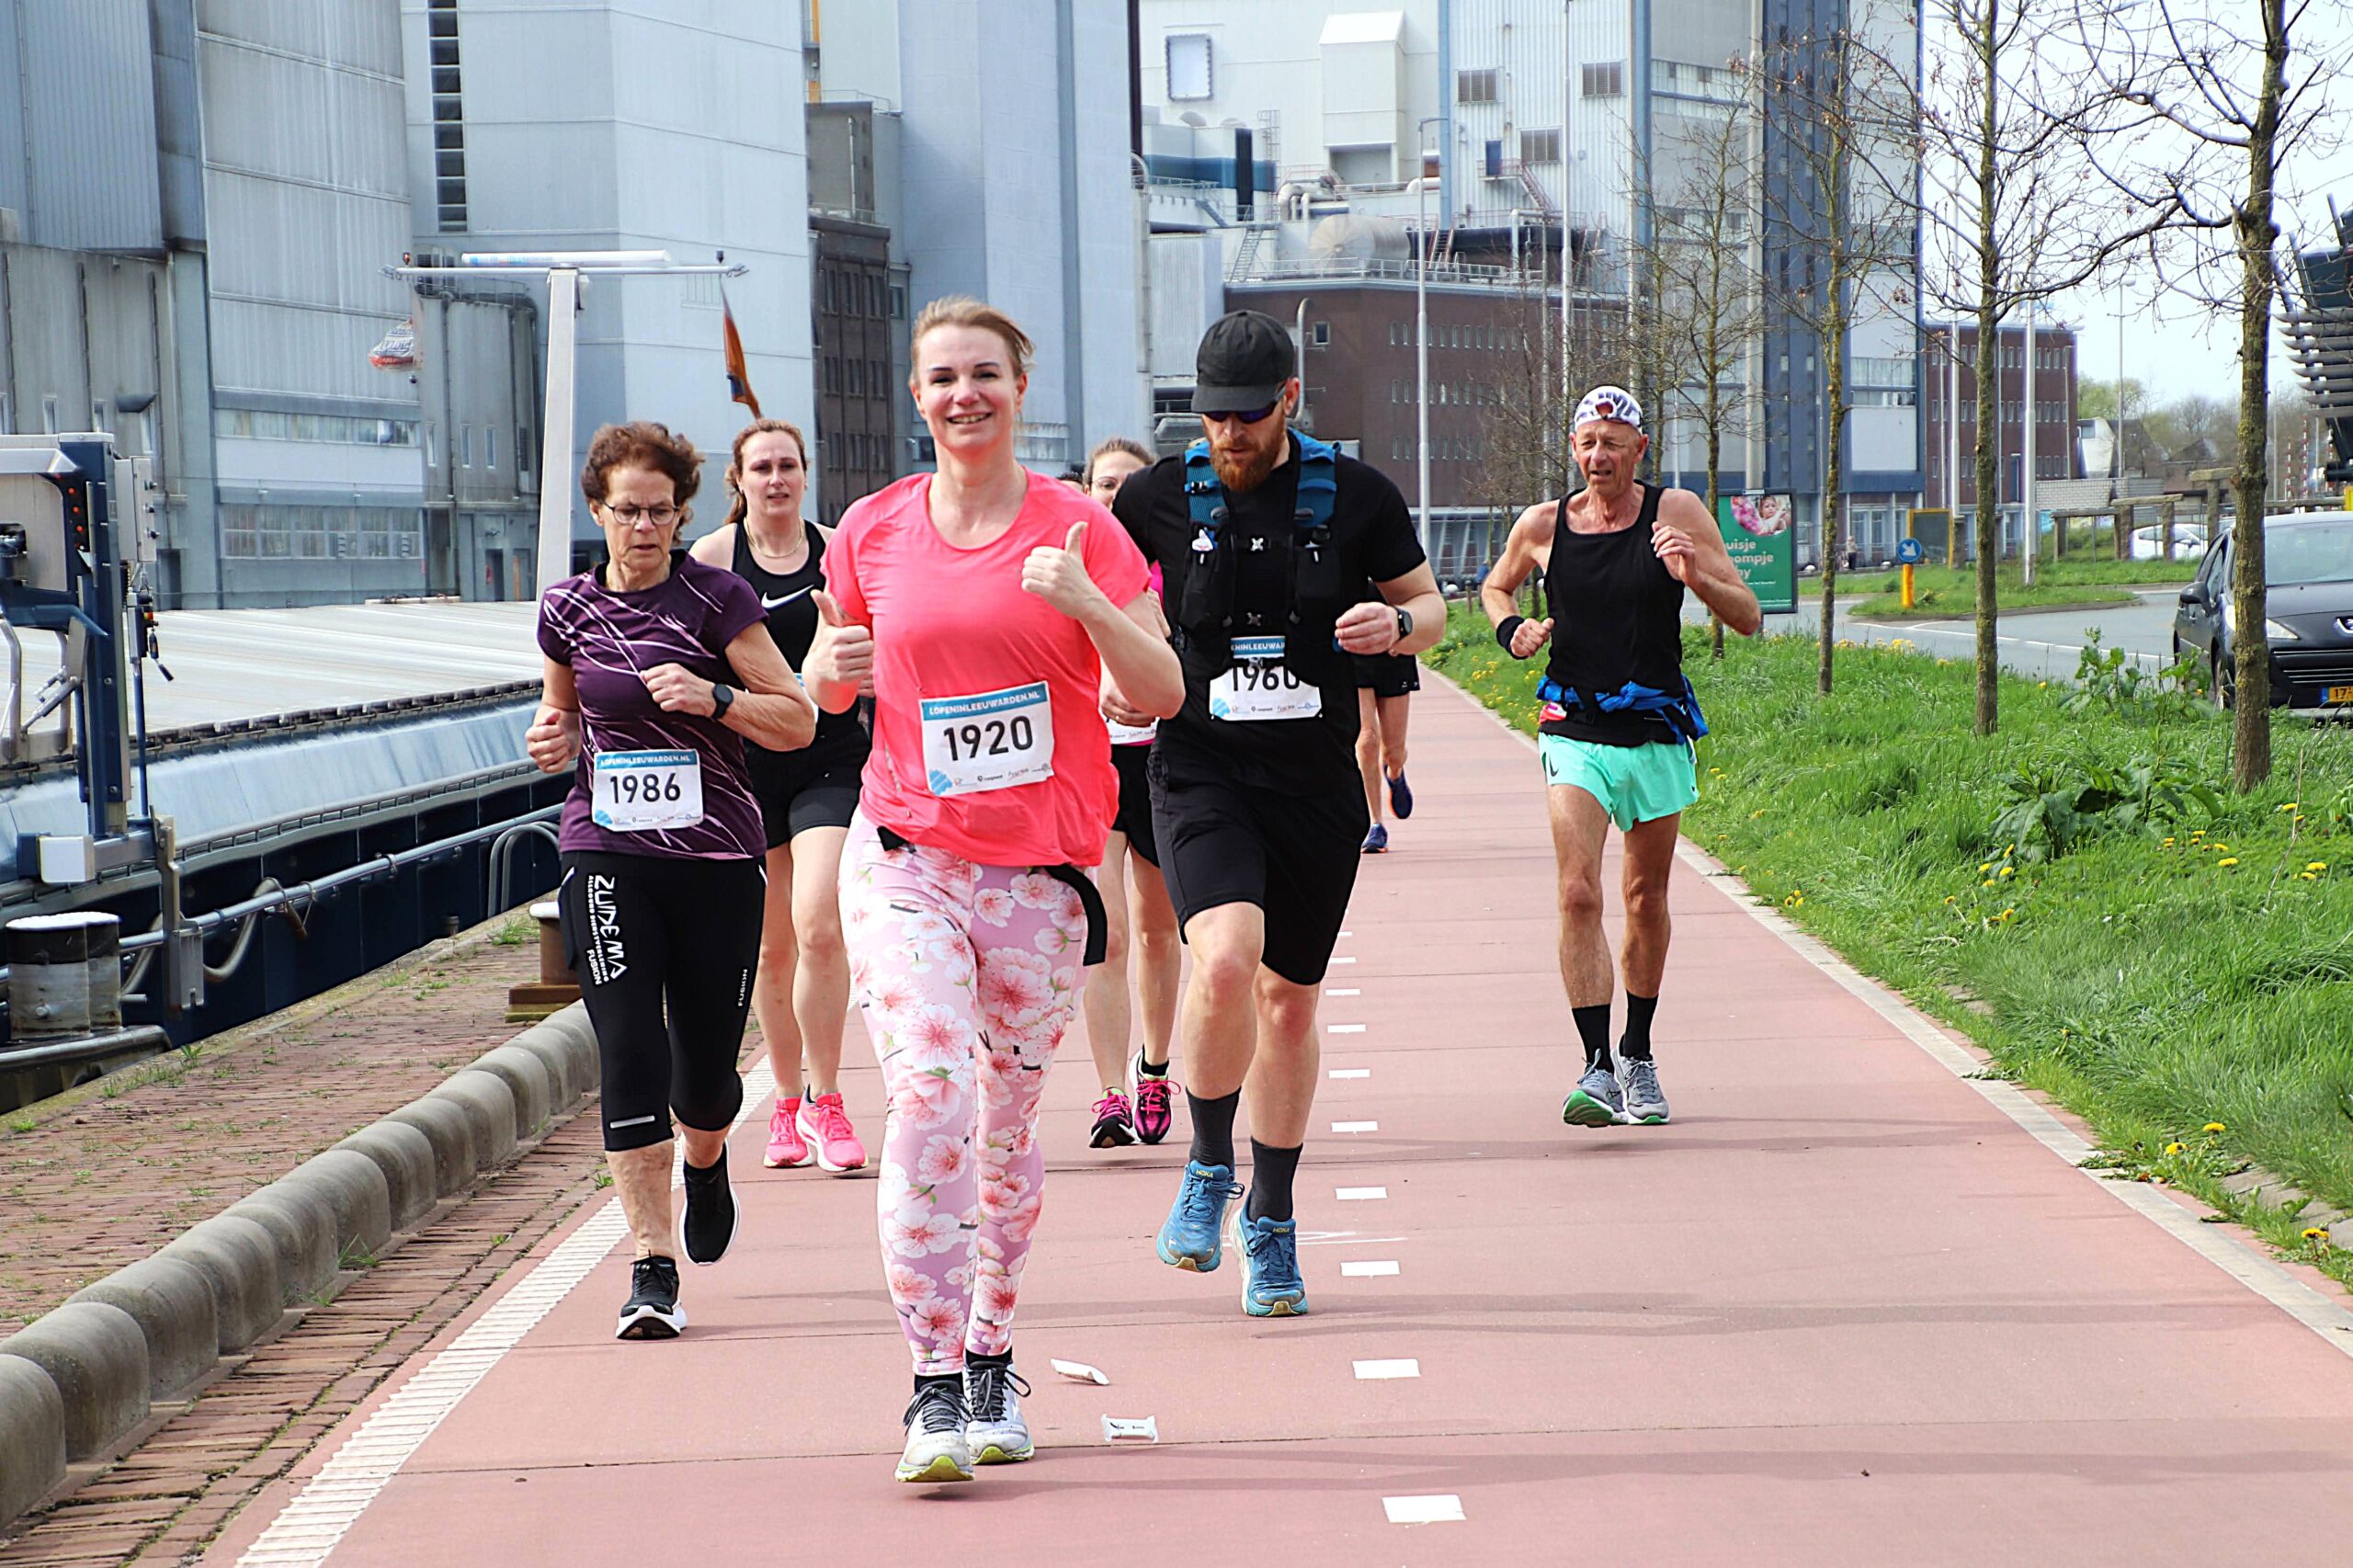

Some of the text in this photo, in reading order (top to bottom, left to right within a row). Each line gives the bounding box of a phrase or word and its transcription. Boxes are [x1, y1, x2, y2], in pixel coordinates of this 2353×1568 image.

[1726, 539, 1756, 552] uisje
[1232, 665, 1300, 691] 1960
[929, 691, 1040, 715] LOPENINLEEUWARDEN.NL
[943, 715, 1033, 761] 1920
[610, 773, 680, 803] 1986
[595, 875, 627, 979] ZUIDEMA
[586, 949, 602, 985] FUSION
[1196, 1168, 1213, 1177] HOKA
